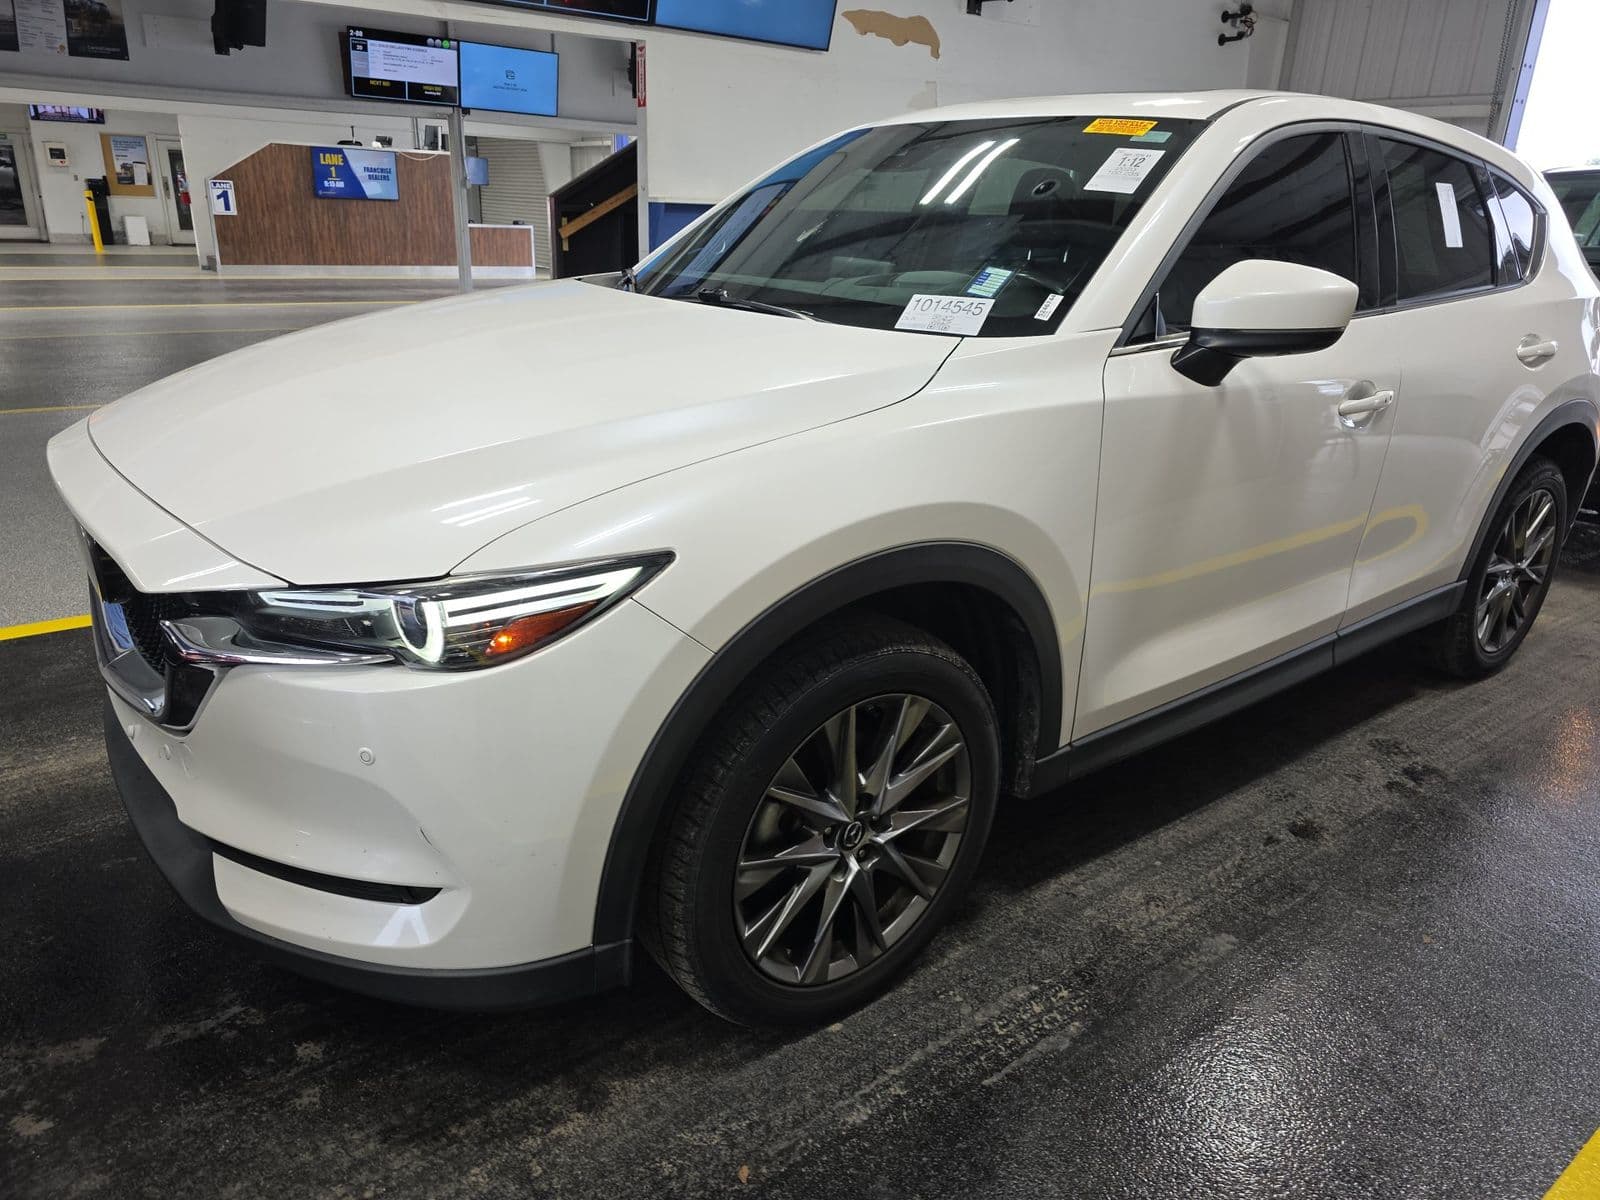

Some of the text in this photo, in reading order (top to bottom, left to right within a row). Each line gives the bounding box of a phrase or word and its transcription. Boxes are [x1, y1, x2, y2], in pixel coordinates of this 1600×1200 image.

[320, 153, 344, 166] LANE
[1118, 156, 1147, 168] 1:12
[329, 166, 336, 178] 1
[363, 166, 392, 175] FRANCHISE
[211, 181, 232, 189] LANE
[216, 190, 231, 212] 1
[912, 298, 986, 316] 1014545
